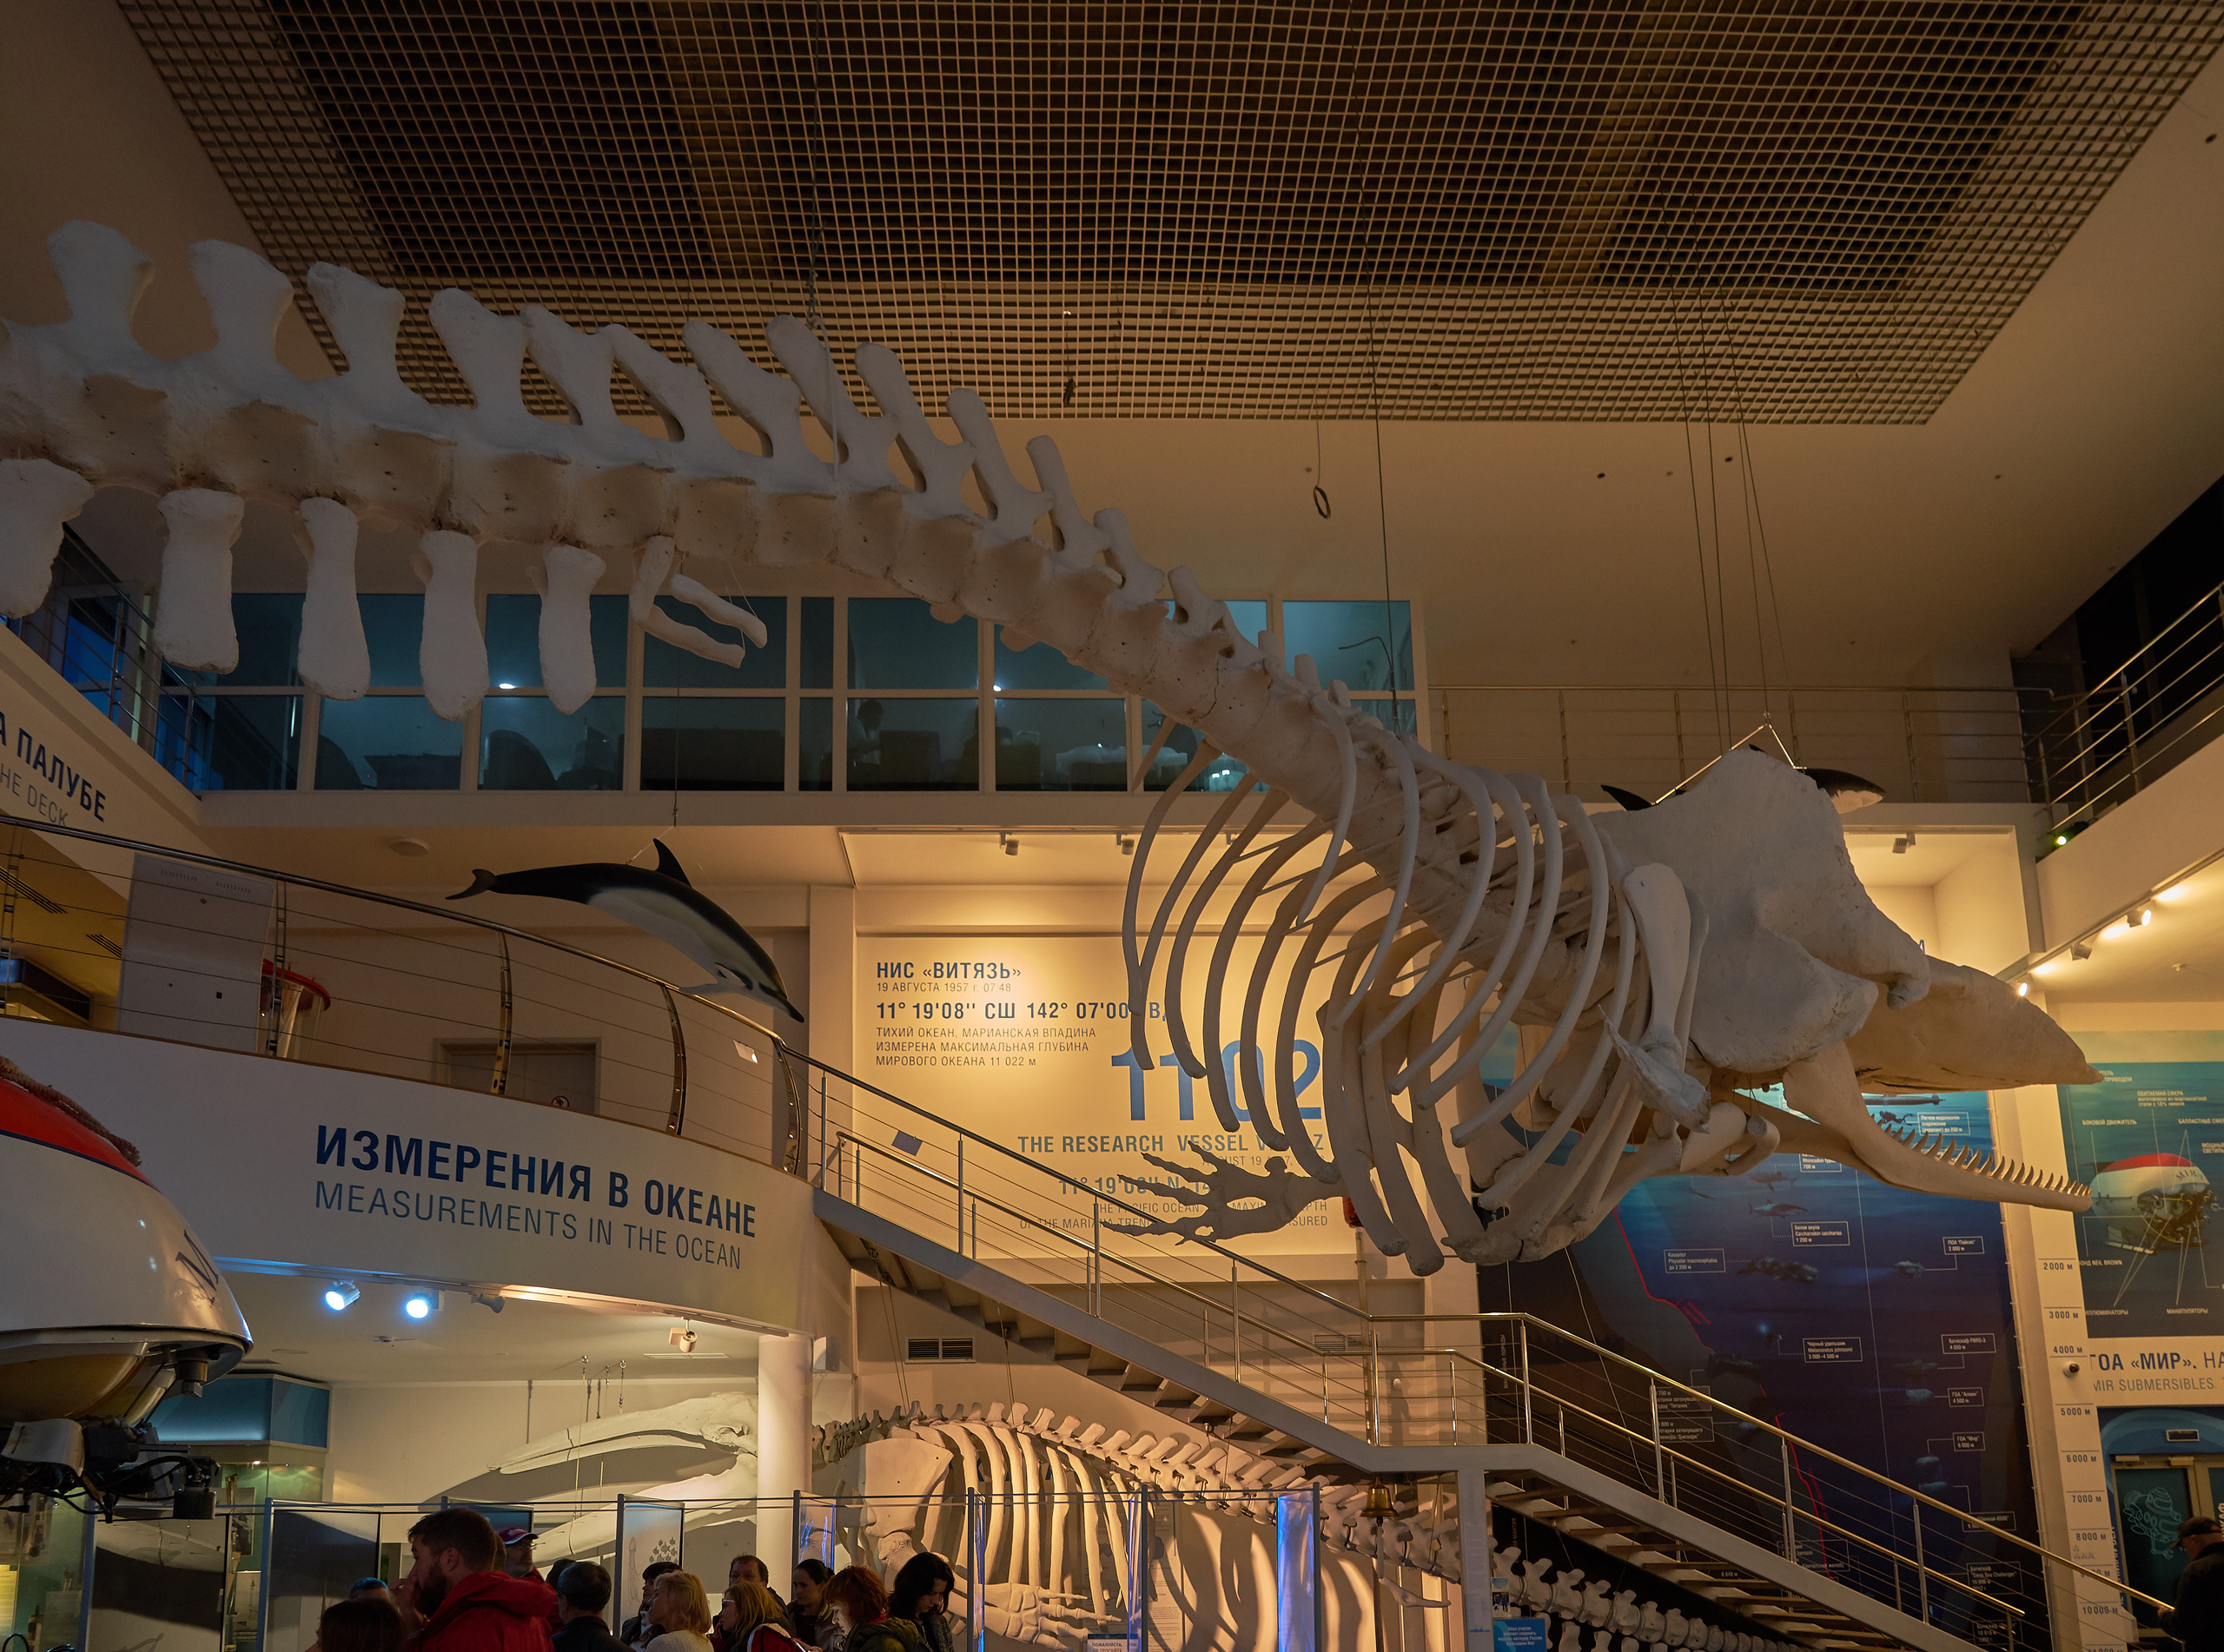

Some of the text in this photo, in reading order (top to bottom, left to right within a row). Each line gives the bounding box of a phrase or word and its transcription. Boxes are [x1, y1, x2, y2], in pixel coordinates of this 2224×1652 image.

[17, 727, 106, 823] ПАЛУБЕ
[0, 763, 69, 827] HE DECK
[877, 961, 1022, 979] НИС «ВИТЯЗЬ»
[877, 982, 889, 992] 19
[892, 982, 940, 992] АВГУСТА
[944, 982, 969, 992] 1957
[983, 982, 1011, 992] 07:48
[877, 1001, 906, 1019] 11°
[984, 1001, 1016, 1019] СШ
[1027, 1001, 1068, 1019] 142°
[1149, 1001, 1167, 1021] В
[877, 1026, 1096, 1039] ТИХИЙ ОКЕАН, МАРИАНСКАЯ ВПАДИНА
[877, 1041, 1089, 1052] ИЗМЕРЕНА МАКСИМАЛЬНАЯ ГЛУБИНА
[876, 1056, 937, 1066] МИРОВОГО
[941, 1056, 986, 1066] ОКЕАНА
[990, 1056, 1000, 1066] 11
[1005, 1056, 1024, 1066] 022
[1111, 1040, 1322, 1122] 1102
[1017, 1136, 1054, 1153] THE
[1062, 1134, 1163, 1153] RESEARCH
[1176, 1134, 1248, 1152] VESSEL
[1251, 1155, 1262, 1166] 19
[316, 1125, 757, 1238] ИЗМЕРЕНИЯ В ОКЕАНЕ
[1099, 1203, 1113, 1213] HE
[314, 1180, 741, 1270] MEASUREMENTS IN THE OCEAN
[2131, 1352, 2197, 1370] «МИР».
